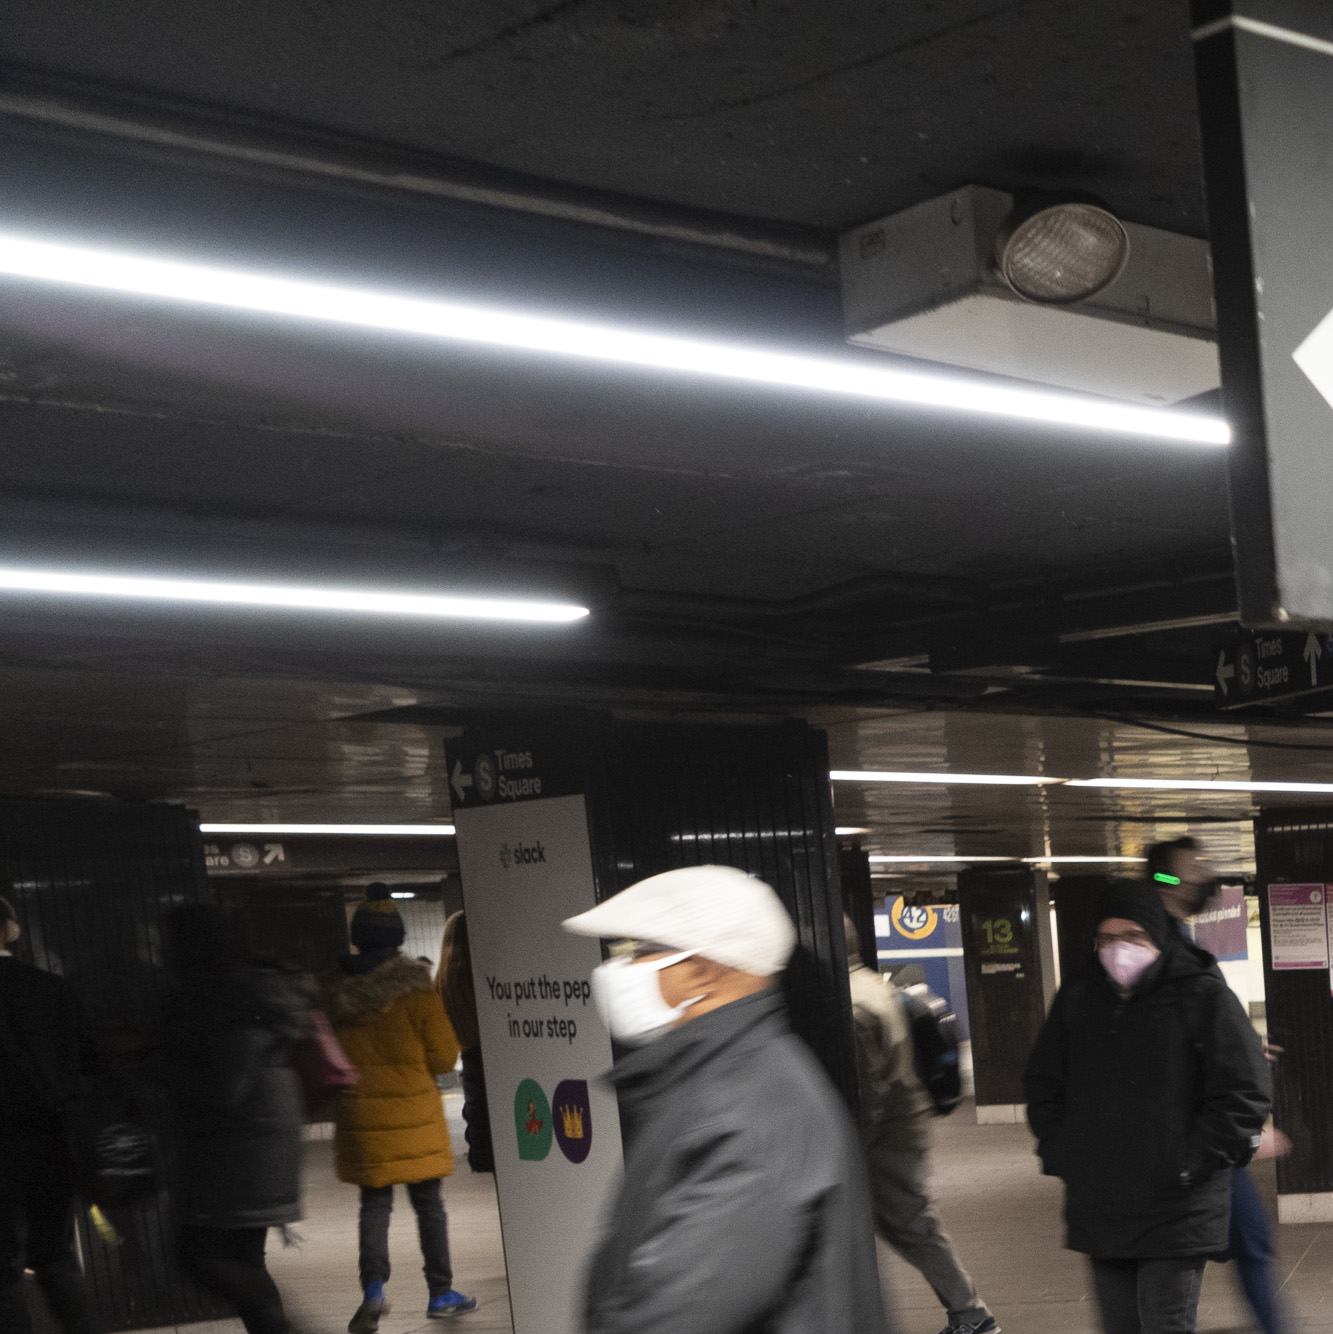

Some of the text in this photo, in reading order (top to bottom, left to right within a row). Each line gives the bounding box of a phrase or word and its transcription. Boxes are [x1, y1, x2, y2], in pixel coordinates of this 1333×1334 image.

[1255, 637, 1283, 659] Times
[1240, 654, 1251, 685] S
[1256, 666, 1289, 689] Square
[495, 749, 533, 771] Times
[479, 760, 493, 792] S
[498, 776, 542, 799] Square
[205, 855, 230, 867] are
[514, 841, 546, 865] slack
[982, 918, 1014, 944] 13
[486, 973, 591, 1007] You put the pep
[507, 1012, 577, 1045] in our step
